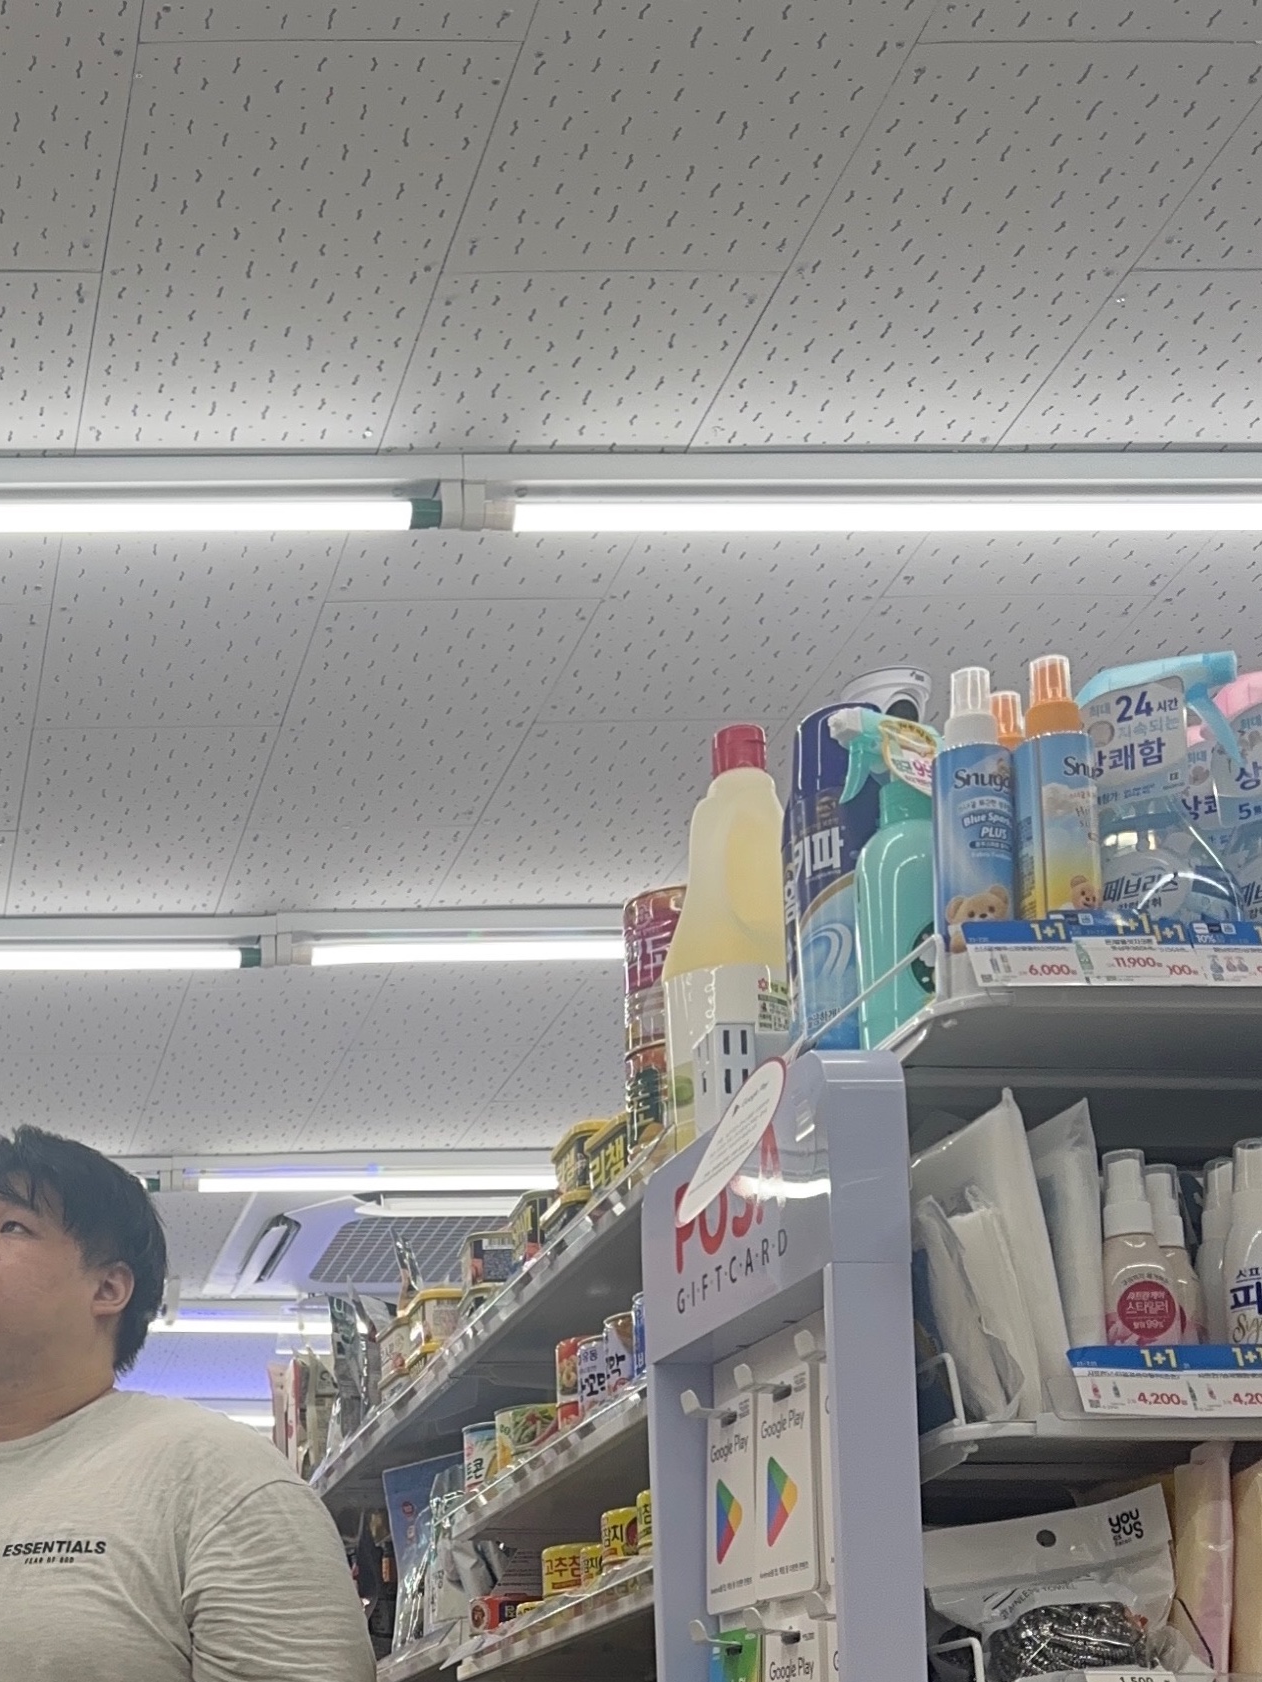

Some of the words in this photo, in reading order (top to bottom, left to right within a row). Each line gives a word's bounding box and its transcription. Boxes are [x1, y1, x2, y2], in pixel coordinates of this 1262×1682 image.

[1089, 703, 1111, 718] 최대
[1115, 691, 1154, 724] 24
[1157, 698, 1178, 712] 시간
[1119, 716, 1180, 739] 지속되는
[962, 814, 987, 828] Blue
[981, 826, 1007, 840] PLUS
[1030, 921, 1067, 941] 1+1
[1152, 922, 1186, 942] 1+1
[590, 1134, 625, 1188] 리챔
[1126, 1300, 1169, 1314] 스타일러
[1140, 1348, 1177, 1368] 1+1
[760, 1414, 788, 1440] Google
[788, 1408, 805, 1431] Play
[710, 1441, 734, 1464] Google
[734, 1434, 749, 1453] Play
[1109, 1508, 1140, 1535] you
[1122, 1521, 1143, 1540] us
[2, 1540, 107, 1557] ESSENTIALS
[24, 1557, 43, 1565] FEAR
[797, 1657, 814, 1681] Play
